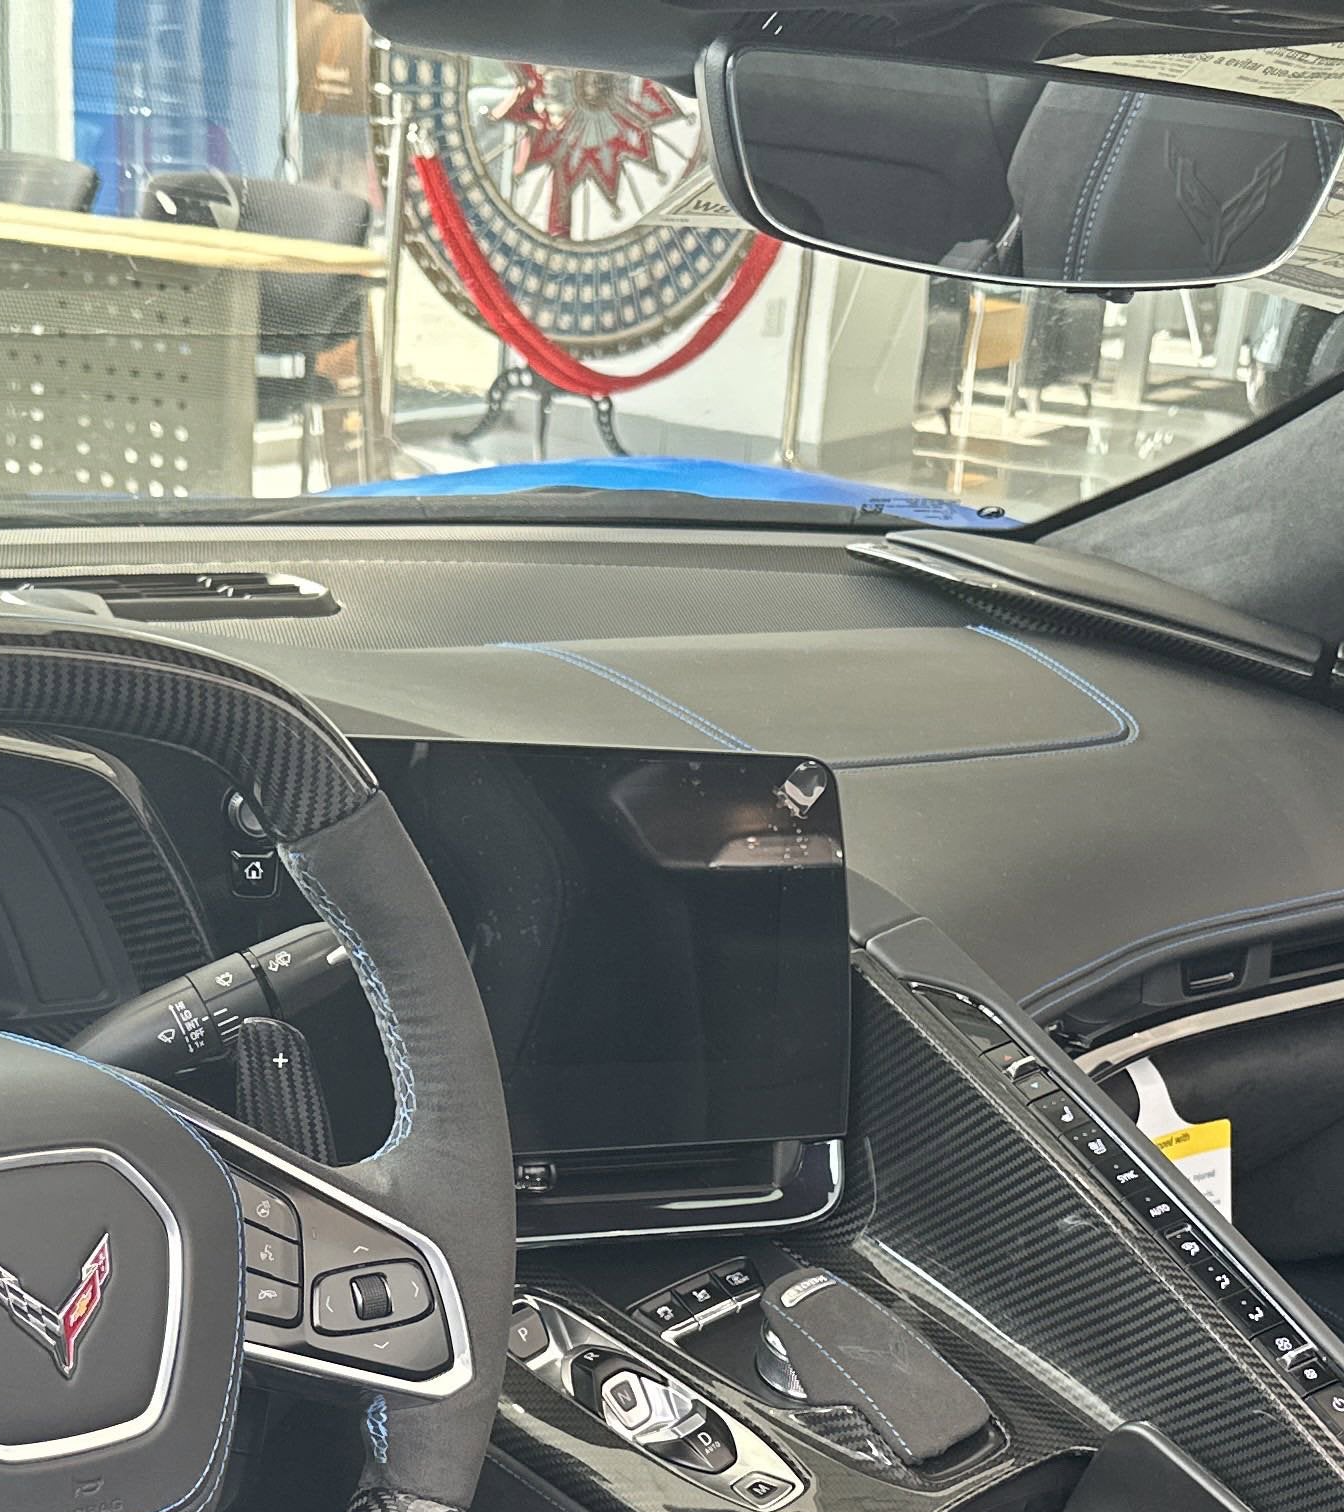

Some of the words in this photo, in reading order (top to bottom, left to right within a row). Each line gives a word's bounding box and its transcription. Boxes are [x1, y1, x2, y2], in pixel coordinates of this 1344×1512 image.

[174, 1000, 187, 1012] HI
[179, 1009, 193, 1022] LO
[184, 1017, 201, 1032] INT
[189, 1026, 205, 1041] OFF
[1116, 1169, 1139, 1184] SYNC
[1149, 1203, 1171, 1218] AUTO
[517, 1327, 529, 1342] P
[583, 1350, 600, 1361] R
[618, 1389, 632, 1404] N
[697, 1431, 713, 1446] D
[704, 1440, 721, 1455] AUTO
[752, 1483, 770, 1496] M
